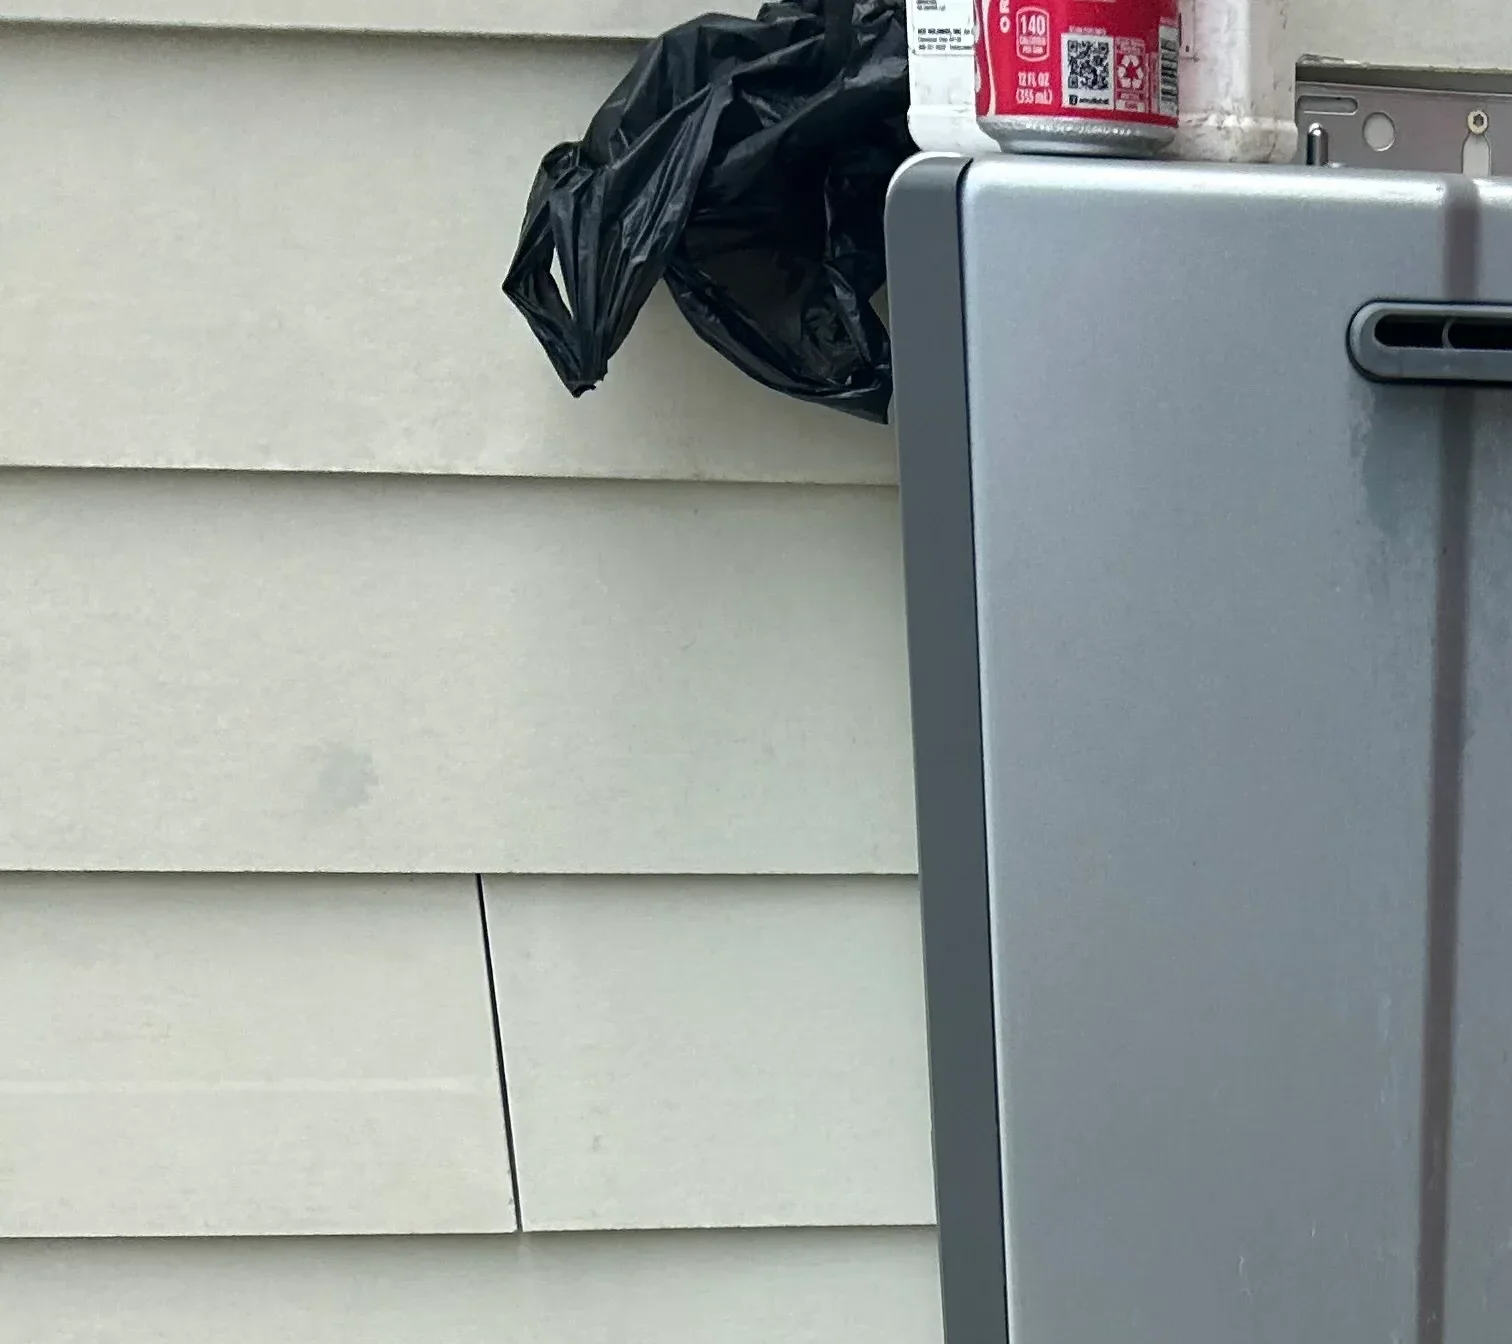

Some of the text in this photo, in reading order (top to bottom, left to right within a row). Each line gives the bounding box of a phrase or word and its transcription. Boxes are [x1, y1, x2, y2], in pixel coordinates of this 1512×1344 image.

[1020, 15, 1046, 35] 140
[1018, 71, 1027, 87] 12
[1038, 71, 1050, 87] OZ
